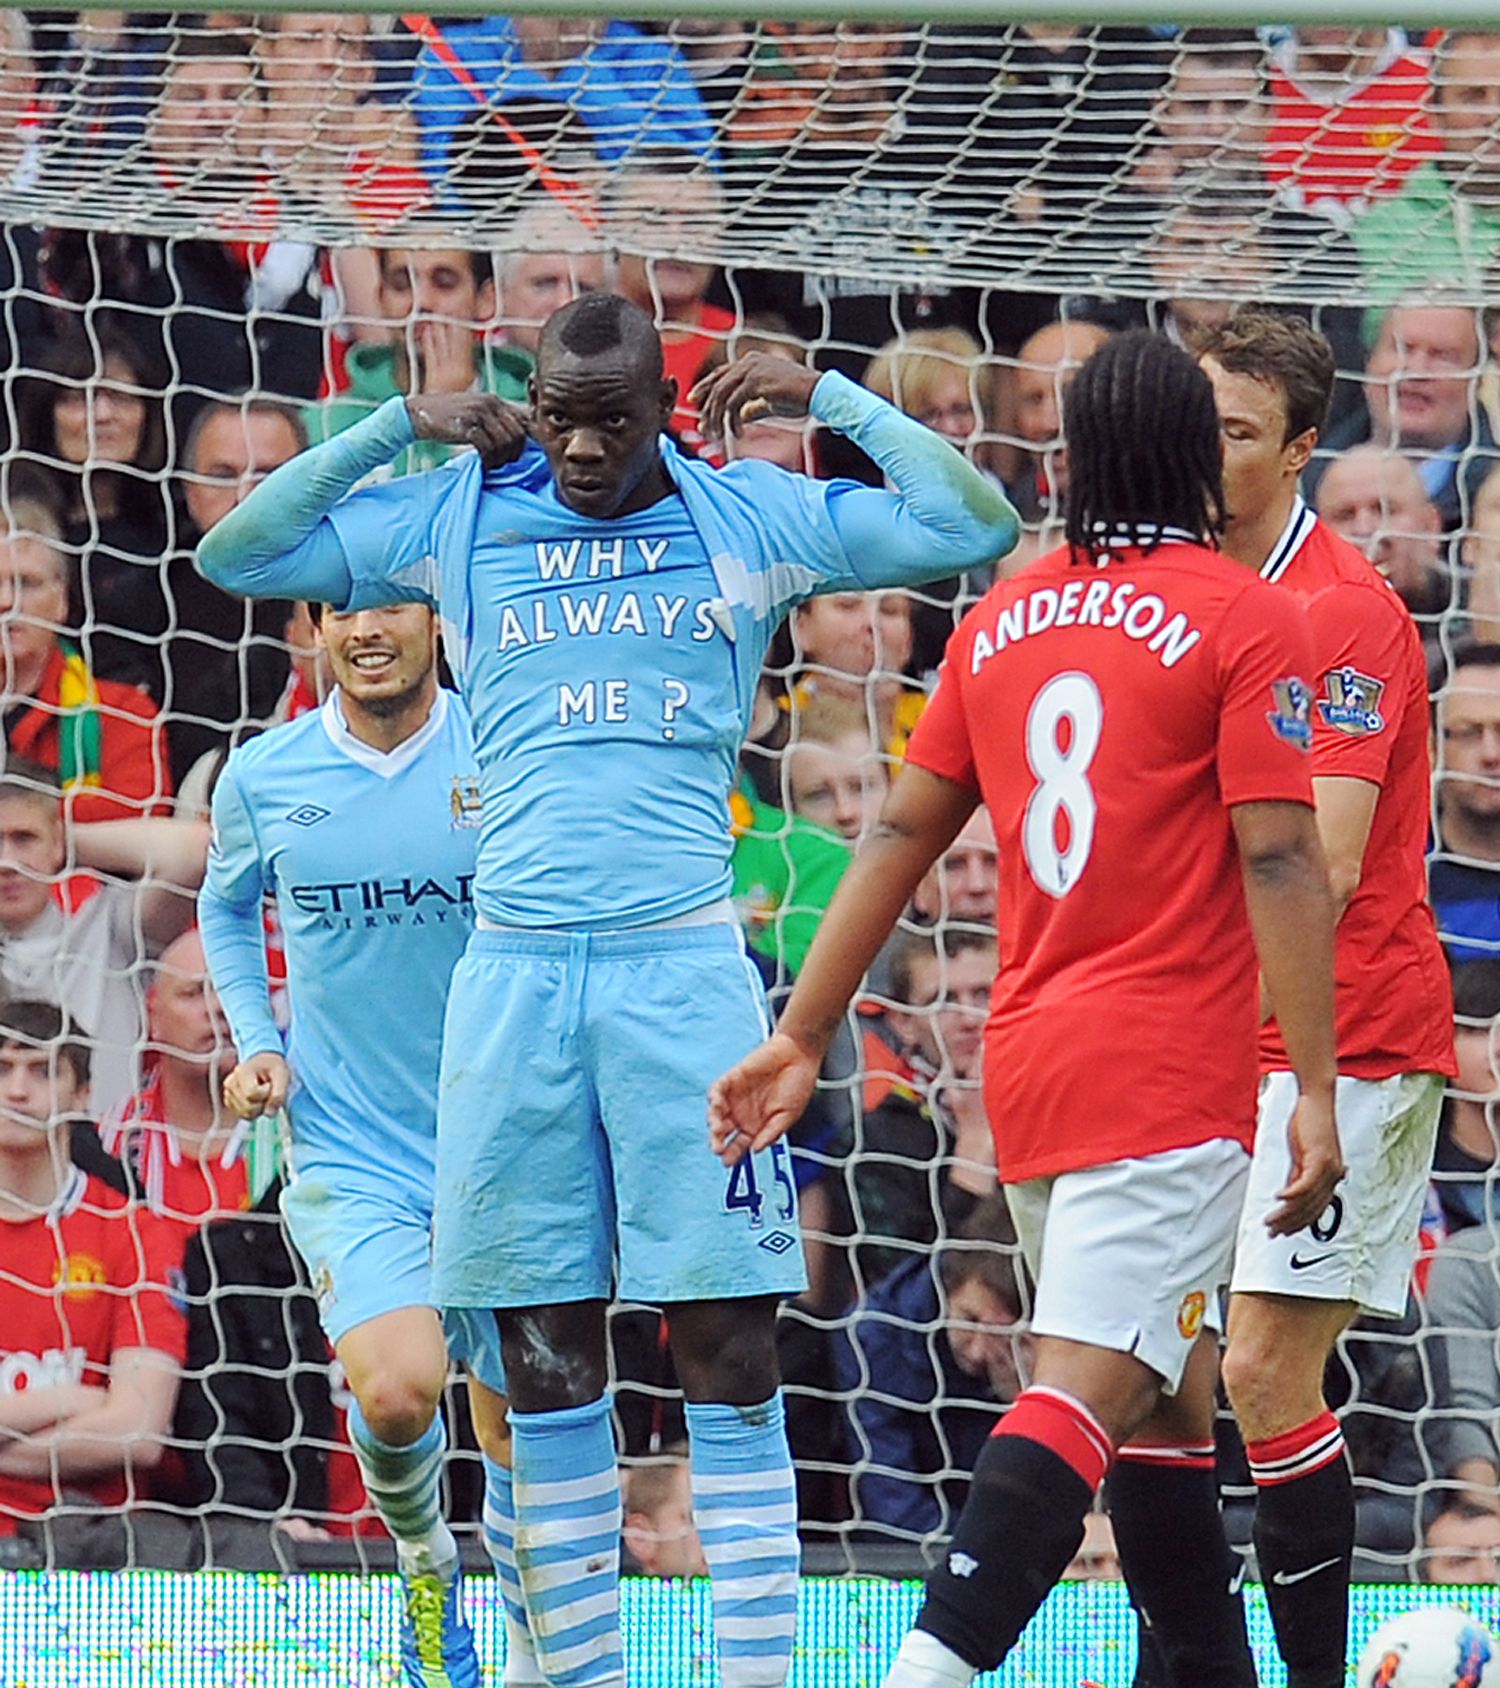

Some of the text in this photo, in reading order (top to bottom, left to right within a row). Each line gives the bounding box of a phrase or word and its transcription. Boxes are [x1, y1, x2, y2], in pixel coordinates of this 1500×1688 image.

[536, 538, 669, 581] WHY
[497, 591, 717, 652] ALWAYS
[971, 579, 1201, 676] ANDERSON
[558, 679, 690, 741] ME ?
[1022, 669, 1104, 899] 8
[323, 906, 469, 930] AIRWAYS
[724, 1142, 796, 1229] 45
[0, 1348, 88, 1394] ON
